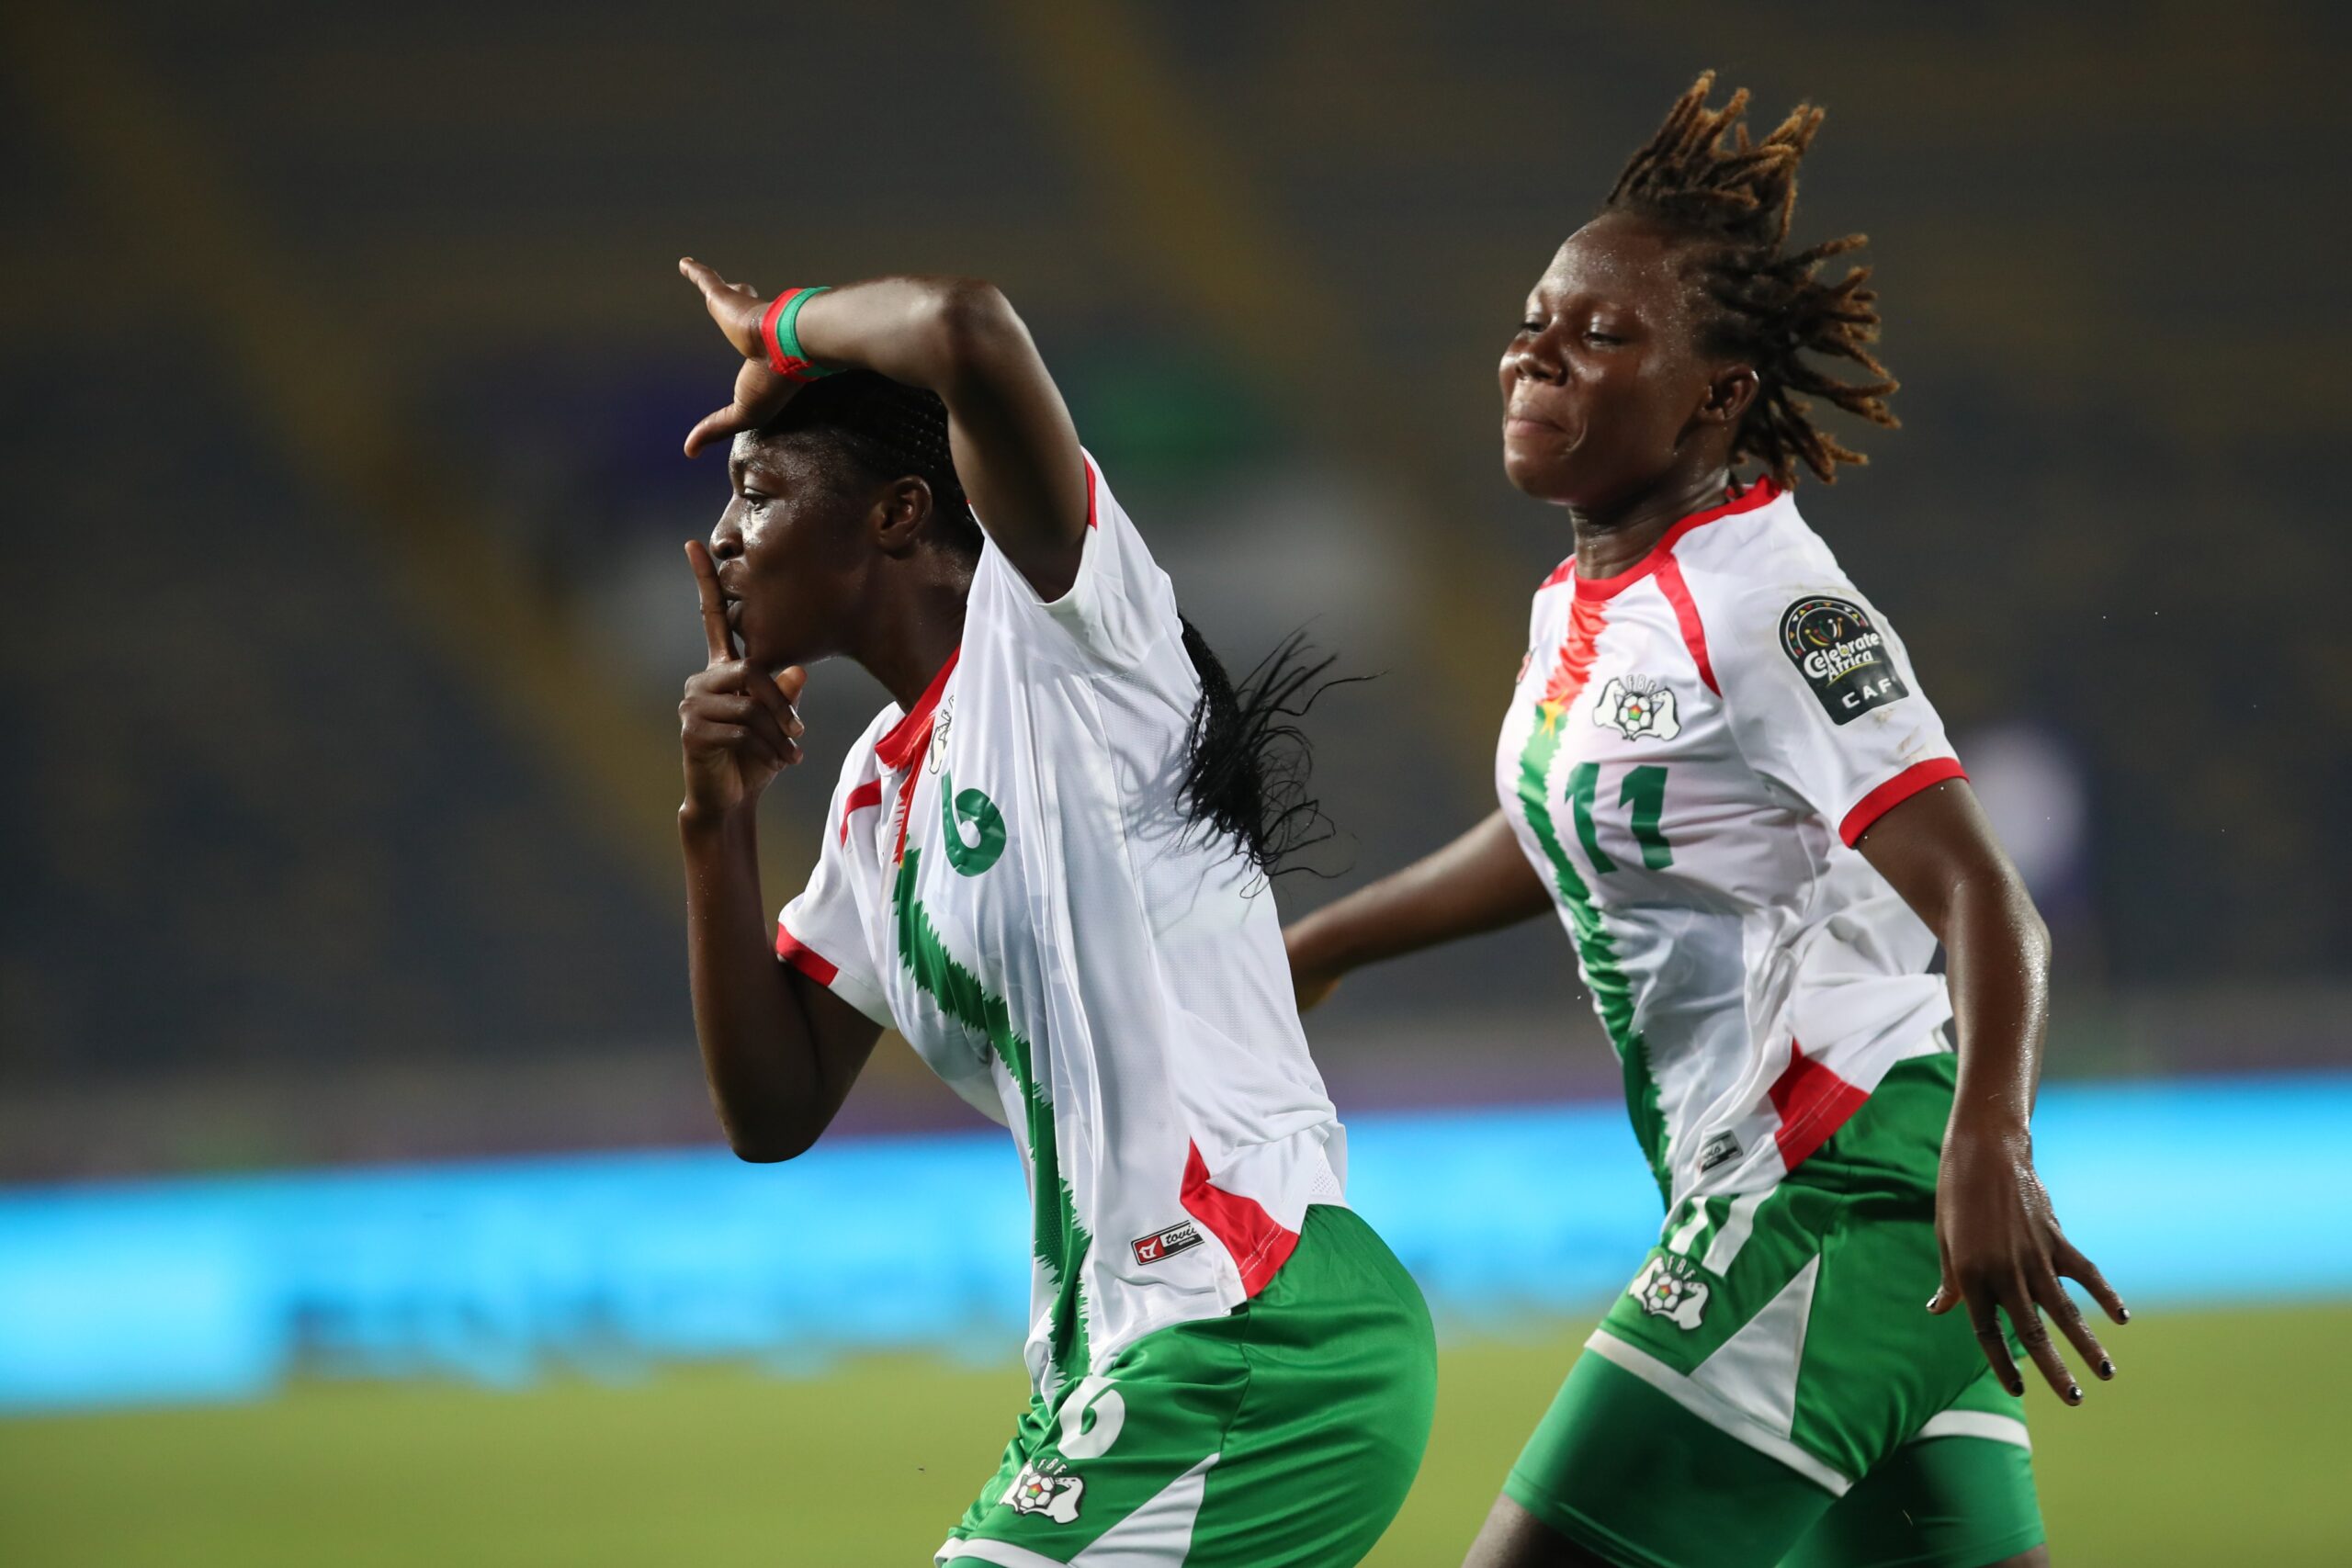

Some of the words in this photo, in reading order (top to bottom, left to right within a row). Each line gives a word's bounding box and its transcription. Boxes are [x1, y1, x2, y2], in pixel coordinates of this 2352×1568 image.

[1804, 632, 1880, 679] Celebrate
[1826, 649, 1873, 682] Africa
[1841, 678, 1892, 708] CAF
[942, 769, 1006, 877] 6
[1565, 761, 1675, 874] 11
[1668, 1184, 1780, 1278] 11
[1057, 1377, 1125, 1460] 6
[1037, 1458, 1067, 1475] FBF
